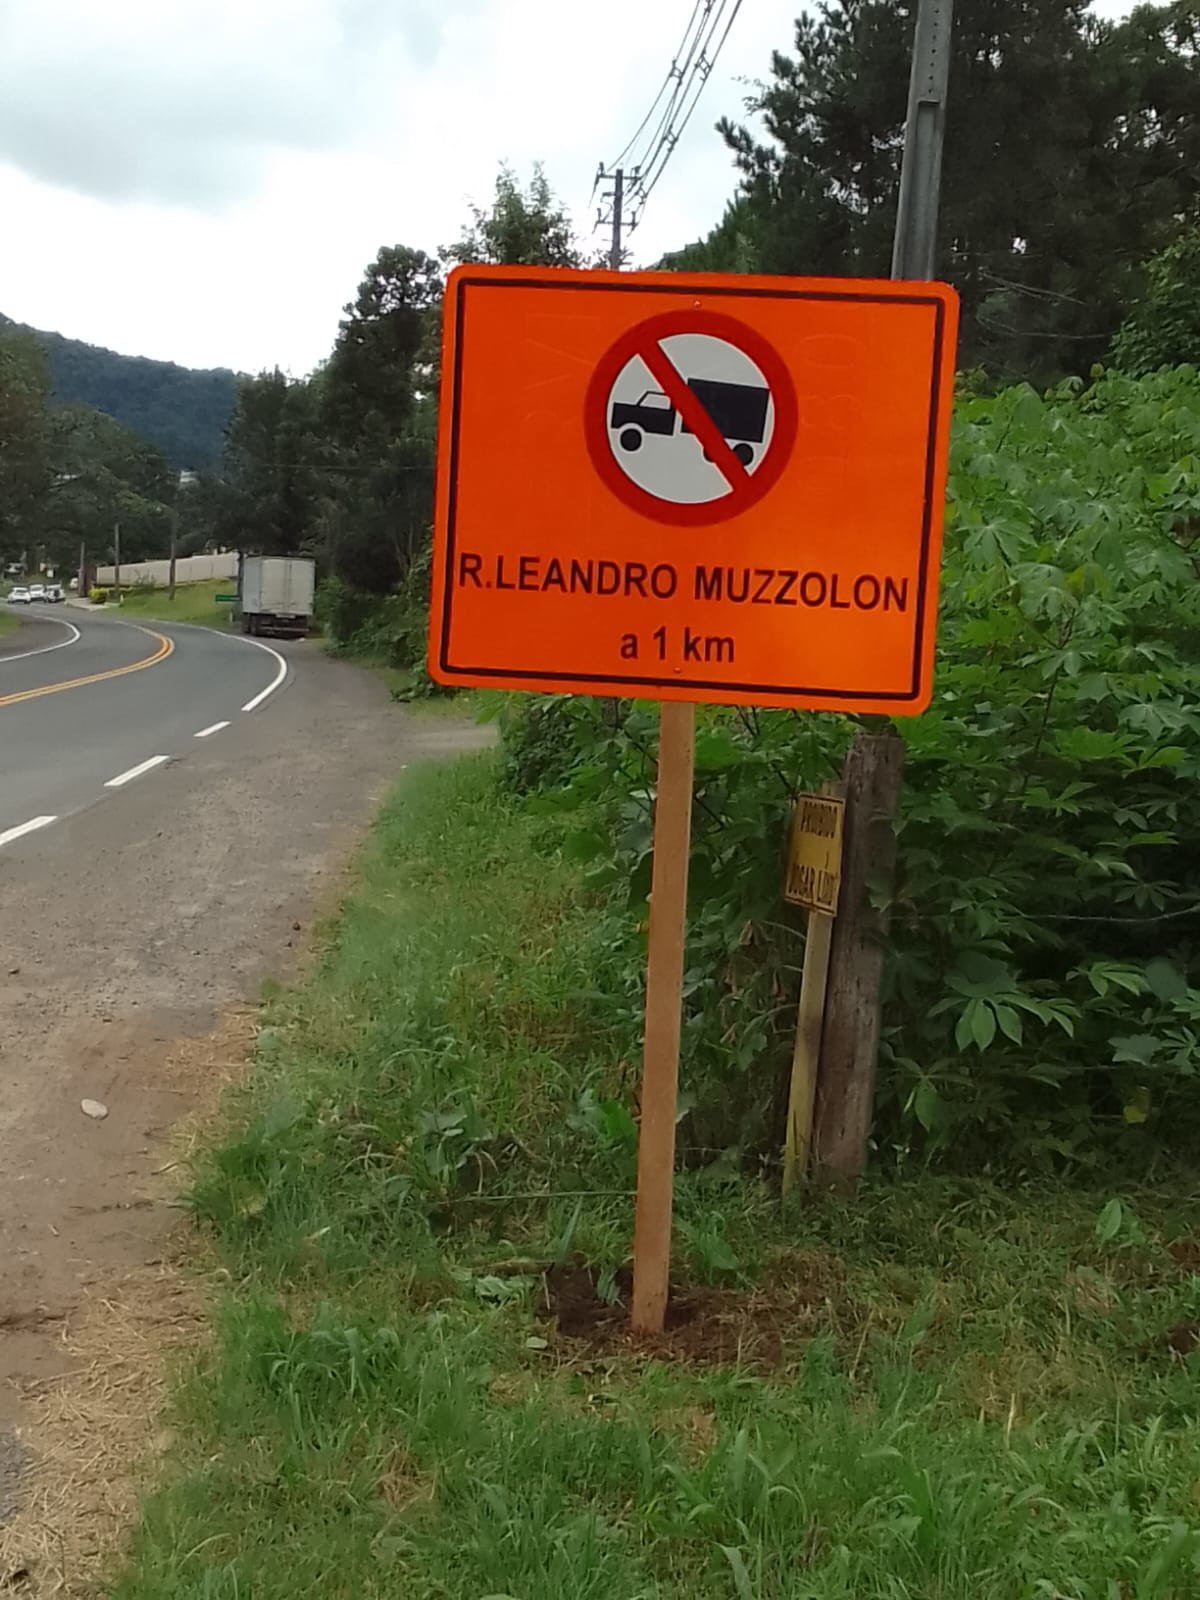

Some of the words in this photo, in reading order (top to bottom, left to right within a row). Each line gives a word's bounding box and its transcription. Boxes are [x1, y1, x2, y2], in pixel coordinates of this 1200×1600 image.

[459, 553, 677, 599] R.LEANDRO
[695, 566, 908, 611] MUZZOLON
[620, 633, 637, 659] a
[653, 626, 667, 660] 1
[684, 627, 735, 662] km
